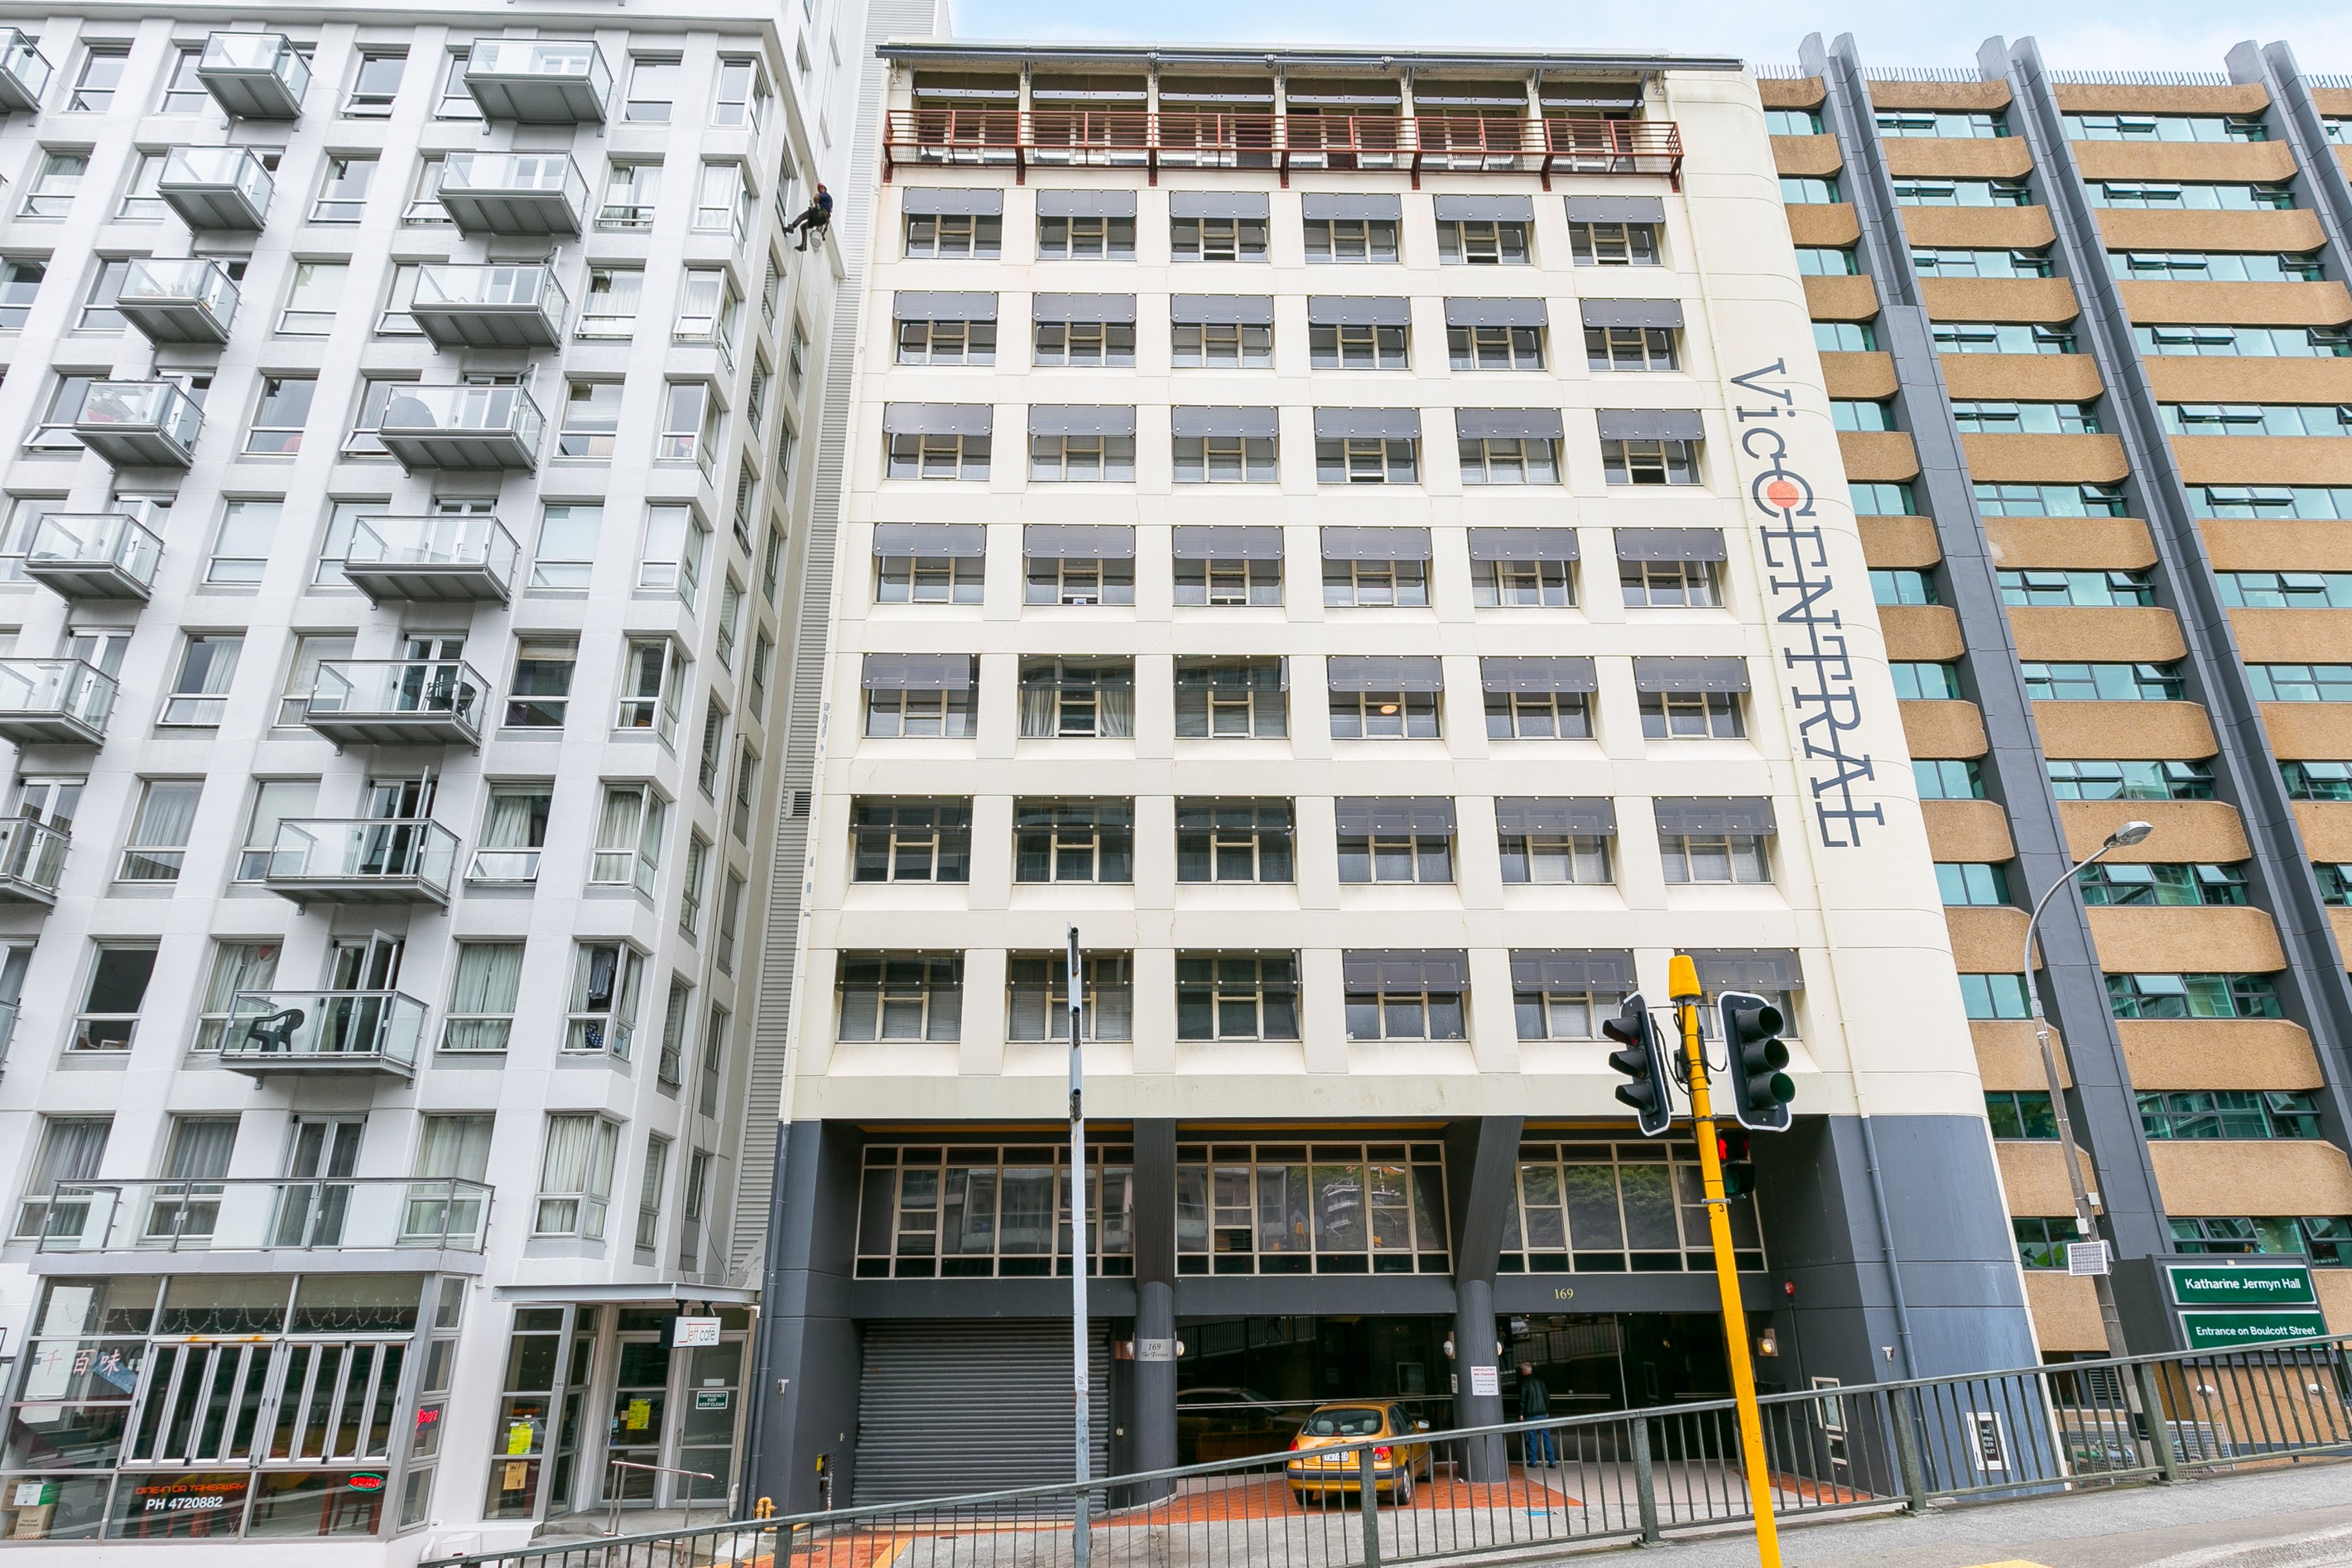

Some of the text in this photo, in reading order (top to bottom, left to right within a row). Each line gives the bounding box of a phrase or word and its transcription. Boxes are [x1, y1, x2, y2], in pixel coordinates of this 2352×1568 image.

[1718, 1204, 1724, 1213] 3
[2184, 1277, 2301, 1291] Katharine Jermyn Hall
[1555, 1288, 1574, 1300] 169
[678, 1320, 700, 1343] Jeff
[2195, 1325, 2317, 1336] Entrance on Boulcott Street
[1148, 1343, 1162, 1351] 169
[42, 1348, 121, 1378] 千百味
[172, 1484, 187, 1493] OR
[190, 1483, 247, 1493] TAKEAWAY
[145, 1496, 224, 1510] PH 4720882
